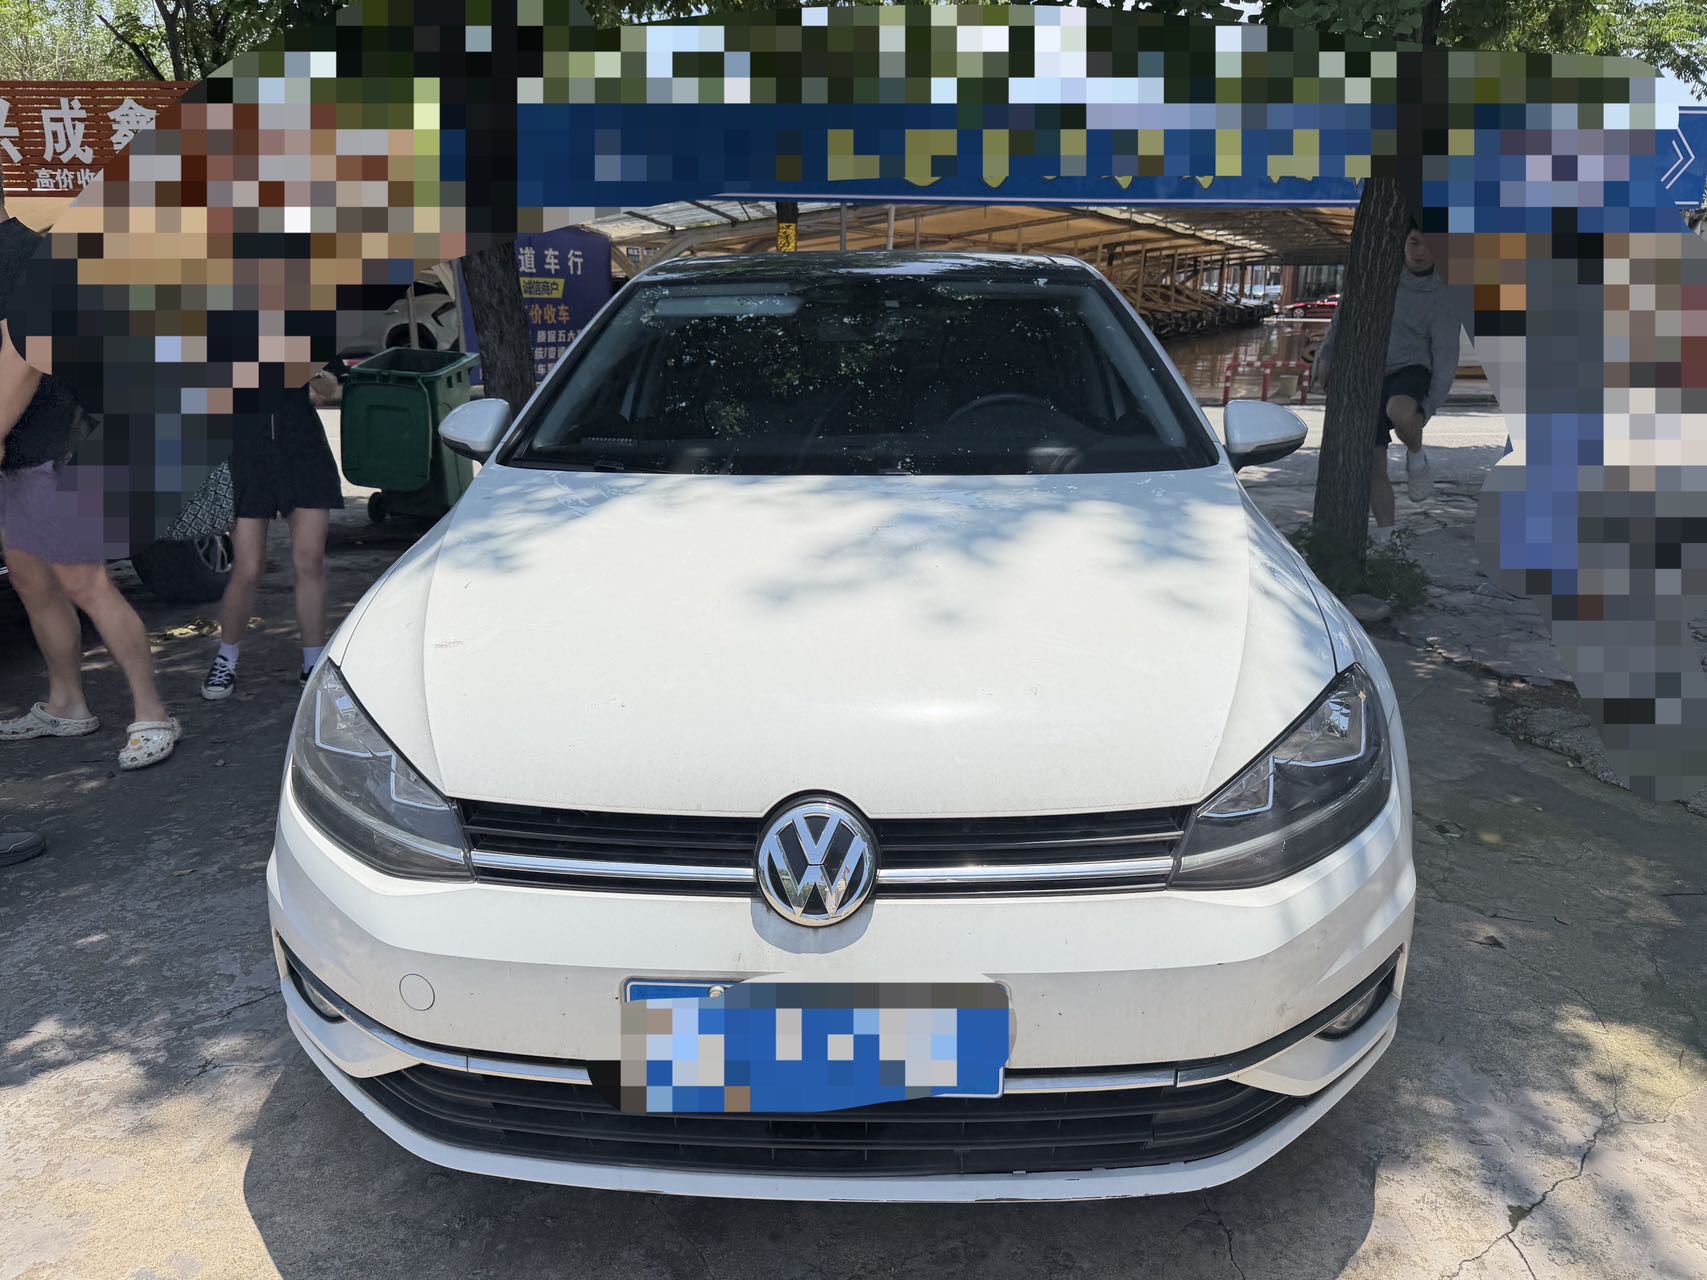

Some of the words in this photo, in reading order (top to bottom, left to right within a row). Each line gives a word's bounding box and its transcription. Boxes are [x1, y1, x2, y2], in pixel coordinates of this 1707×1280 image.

[518, 247, 583, 275] 道车行
[525, 304, 570, 325] 价收车
